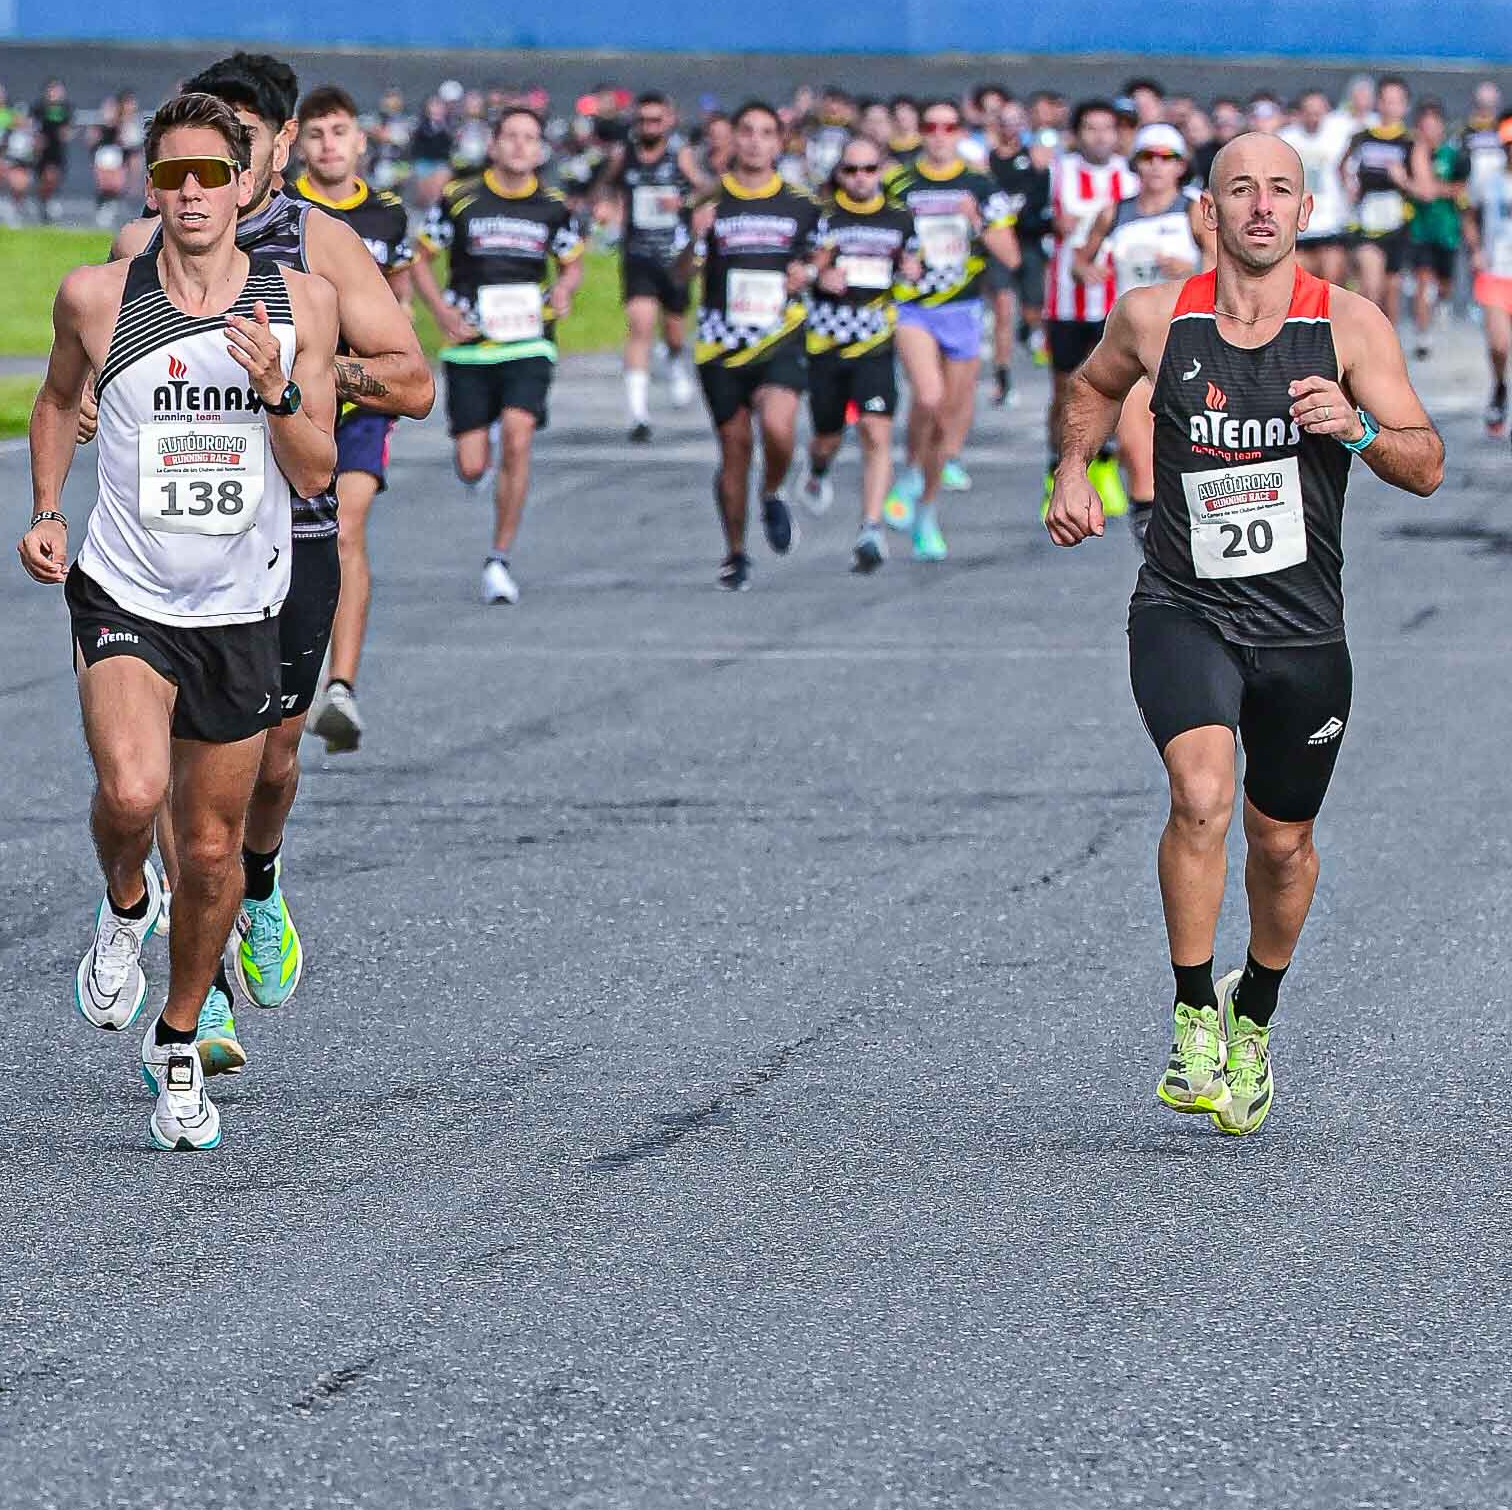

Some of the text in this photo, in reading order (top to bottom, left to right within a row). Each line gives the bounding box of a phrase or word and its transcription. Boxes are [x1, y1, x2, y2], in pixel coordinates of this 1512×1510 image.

[153, 380, 260, 411] ATENAS
[153, 412, 221, 423] running team
[1189, 410, 1300, 449] ATENAS
[158, 431, 247, 454] AUTÓDROMO
[1191, 444, 1262, 461] running team
[172, 453, 233, 466] RUNNING RACE
[160, 480, 244, 516] 138
[1197, 473, 1283, 500] AUTÓDROMO
[1212, 491, 1271, 509] RUNNING RACE
[1219, 519, 1274, 559] 20
[96, 631, 140, 649] ATENAS
